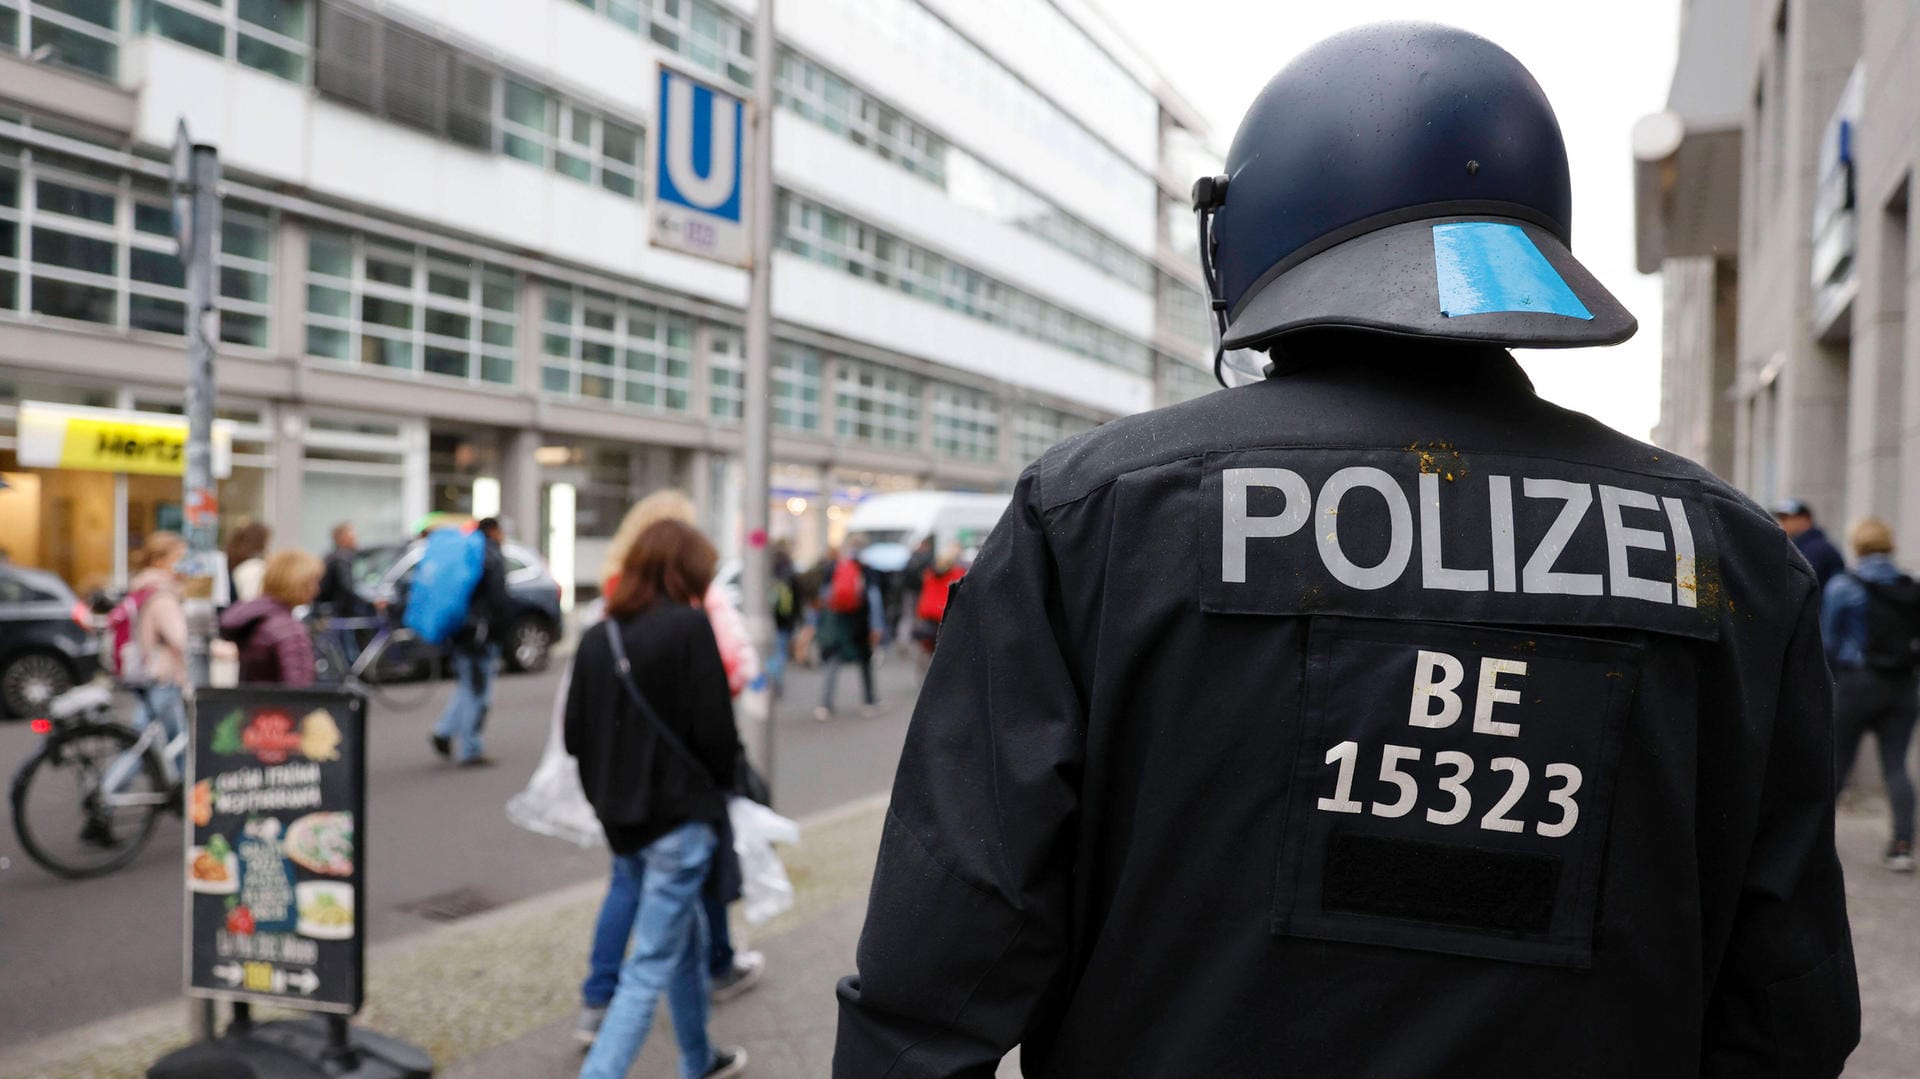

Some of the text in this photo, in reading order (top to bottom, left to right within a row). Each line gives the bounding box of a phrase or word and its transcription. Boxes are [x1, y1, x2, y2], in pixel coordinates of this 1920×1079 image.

[668, 78, 736, 210] U
[96, 431, 183, 461] Hertz
[1222, 467, 1697, 608] POLIZEI
[1408, 650, 1529, 737] BE
[1317, 741, 1583, 837] 15323
